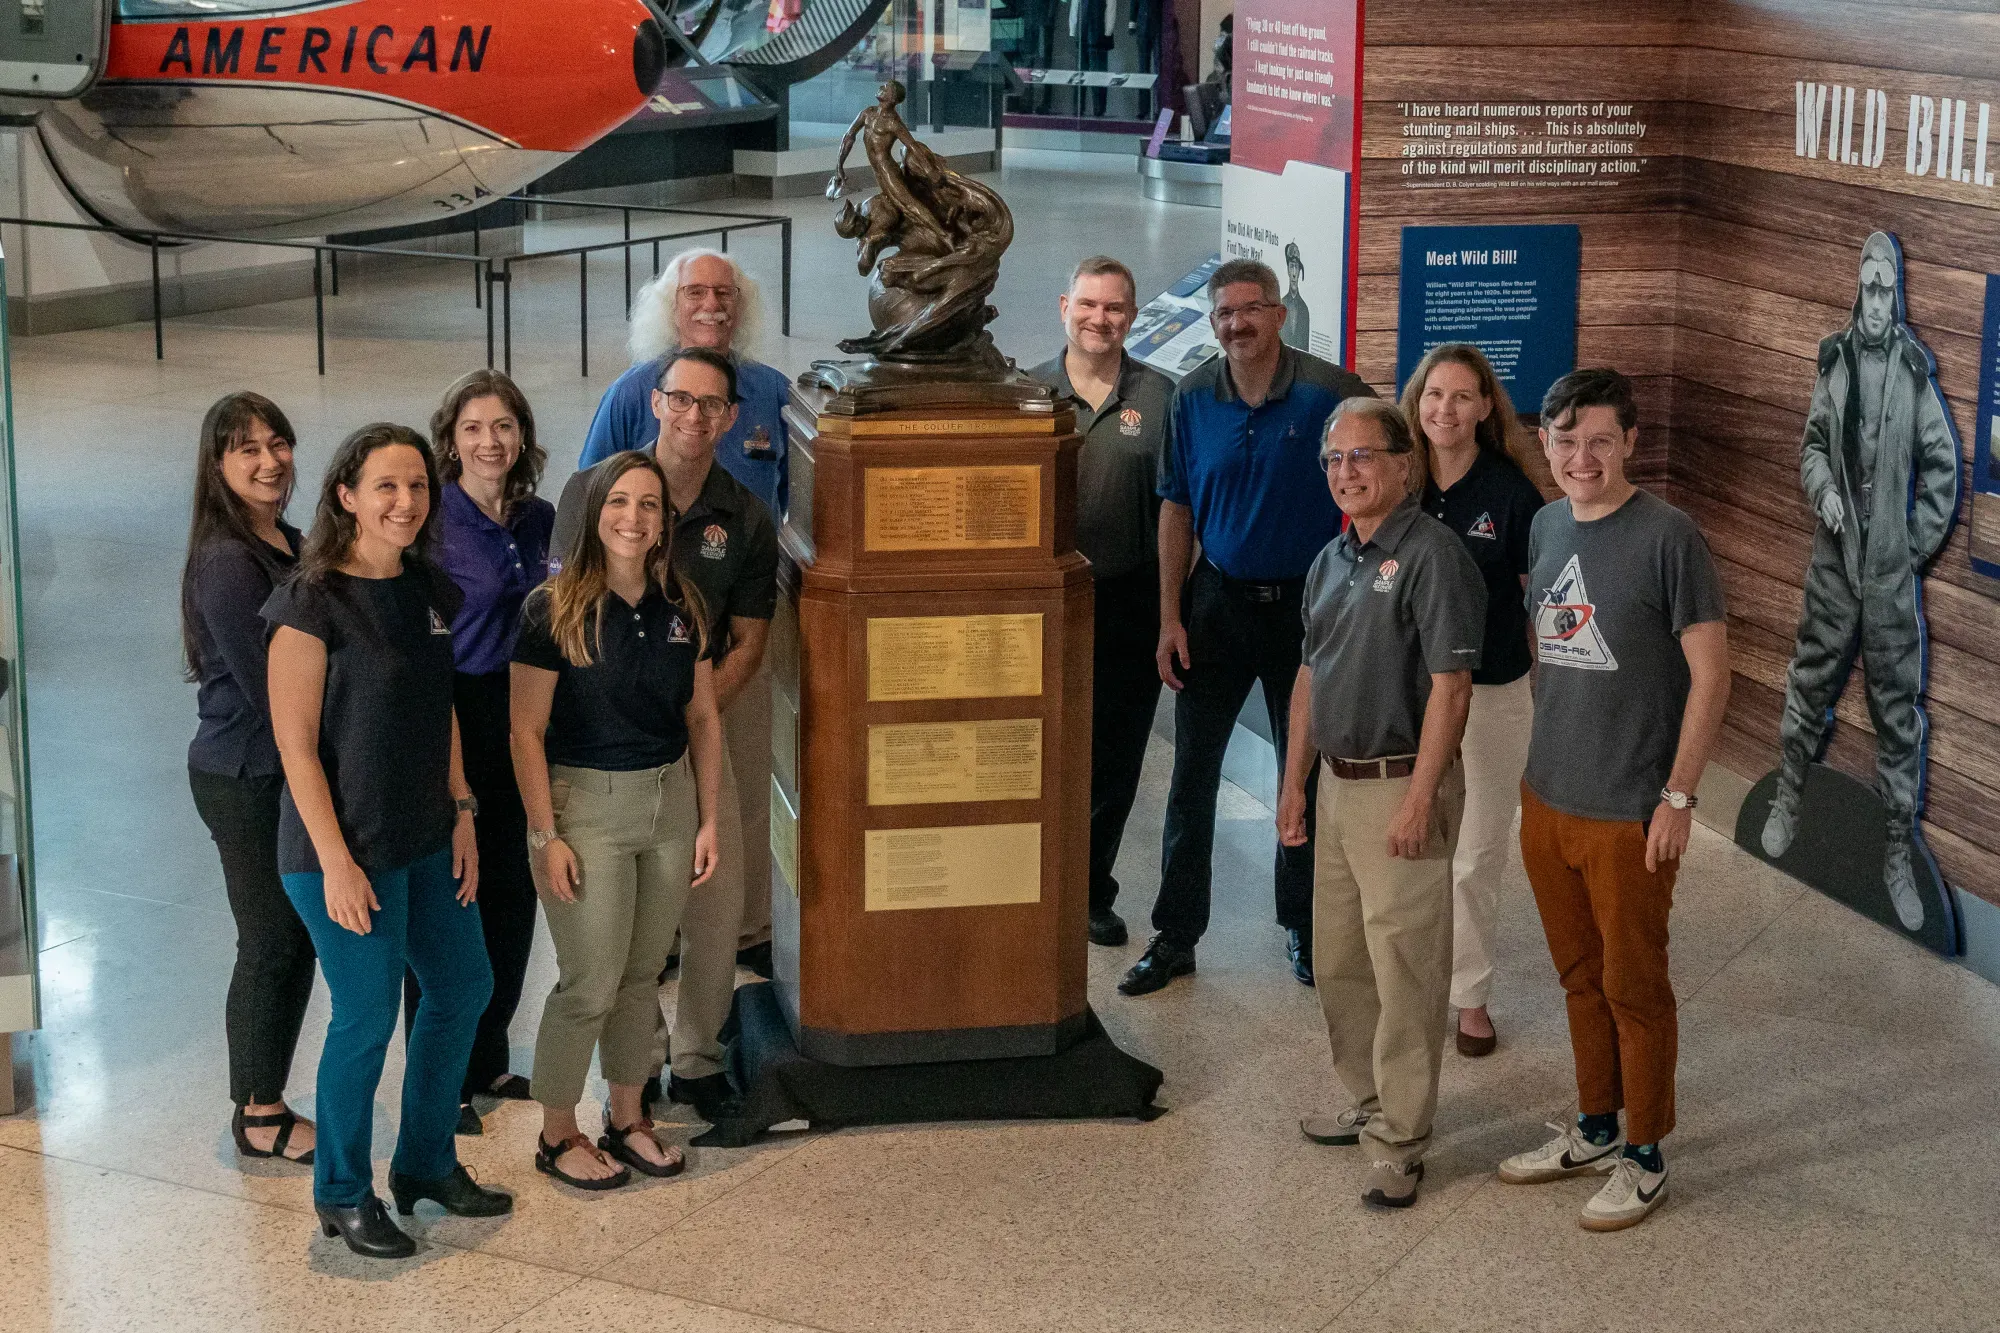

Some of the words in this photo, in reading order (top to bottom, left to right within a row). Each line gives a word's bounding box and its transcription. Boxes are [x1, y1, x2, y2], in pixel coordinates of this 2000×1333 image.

[1268, 22, 1274, 33] or
[1274, 21, 1281, 34] 40
[1281, 22, 1291, 35] feet
[1291, 23, 1299, 36] off
[1299, 24, 1308, 37] the
[1308, 26, 1327, 42] ground,
[159, 24, 492, 74] AMERICAN
[1250, 39, 1259, 52] still
[1279, 42, 1288, 56] find
[1288, 44, 1297, 57] the
[1297, 45, 1317, 60] railroad
[1317, 48, 1335, 63] tracks.
[1258, 62, 1268, 76] kept
[1269, 62, 1286, 80] looking
[1286, 65, 1294, 78] for
[1294, 67, 1304, 81] just
[1305, 70, 1314, 81] one
[1314, 69, 1334, 87] friendly
[1246, 79, 1267, 94] landmark
[1268, 83, 1273, 95] to
[1281, 87, 1288, 98] me
[1289, 86, 1302, 101] know
[1302, 89, 1317, 104] where
[1397, 102, 1408, 117] “I
[1412, 103, 1441, 117] have
[1445, 102, 1479, 117] heard
[1483, 104, 1541, 116] numerous
[1545, 103, 1588, 119] reports
[1592, 102, 1604, 116] of
[1606, 104, 1633, 119] your
[1403, 122, 1452, 138] stunting
[1455, 122, 1481, 136] mail
[1484, 122, 1519, 138] ships.
[1546, 121, 1569, 135] This
[1573, 122, 1583, 135] is
[1586, 121, 1646, 138] absolutely
[1795, 80, 1887, 169] WILD
[1905, 93, 1995, 187] BILL
[1402, 142, 1447, 158] against
[1450, 141, 1517, 157] regulations
[1521, 140, 1542, 154] and
[1546, 140, 1587, 154] further
[1591, 141, 1633, 154] actions
[1402, 160, 1414, 174] of
[1417, 160, 1436, 174] the
[1441, 160, 1466, 174] kind
[1469, 160, 1490, 174] will
[1493, 160, 1526, 174] merit
[1529, 160, 1597, 176] disciplinary
[1600, 159, 1647, 173] action.”
[1227, 220, 1237, 234] How
[1238, 222, 1246, 237] Did
[1246, 224, 1254, 239] Air
[1254, 226, 1264, 243] Mail
[1265, 229, 1279, 247] Pilots
[1227, 240, 1237, 254] Find
[1238, 242, 1250, 258] Their
[1250, 246, 1263, 261] Way?
[1426, 251, 1458, 266] Meet
[1461, 250, 1488, 265] Wild
[1492, 250, 1517, 265] Bill!
[1434, 290, 1450, 298] eight
[1463, 298, 1471, 306] by
[1471, 297, 1497, 305] breaking
[1497, 297, 1515, 305] speed
[1454, 315, 1471, 323] pilots
[1482, 314, 1507, 322] regularly
[1466, 306, 1494, 314] airplanes.
[923, 423, 964, 431] COLLIER
